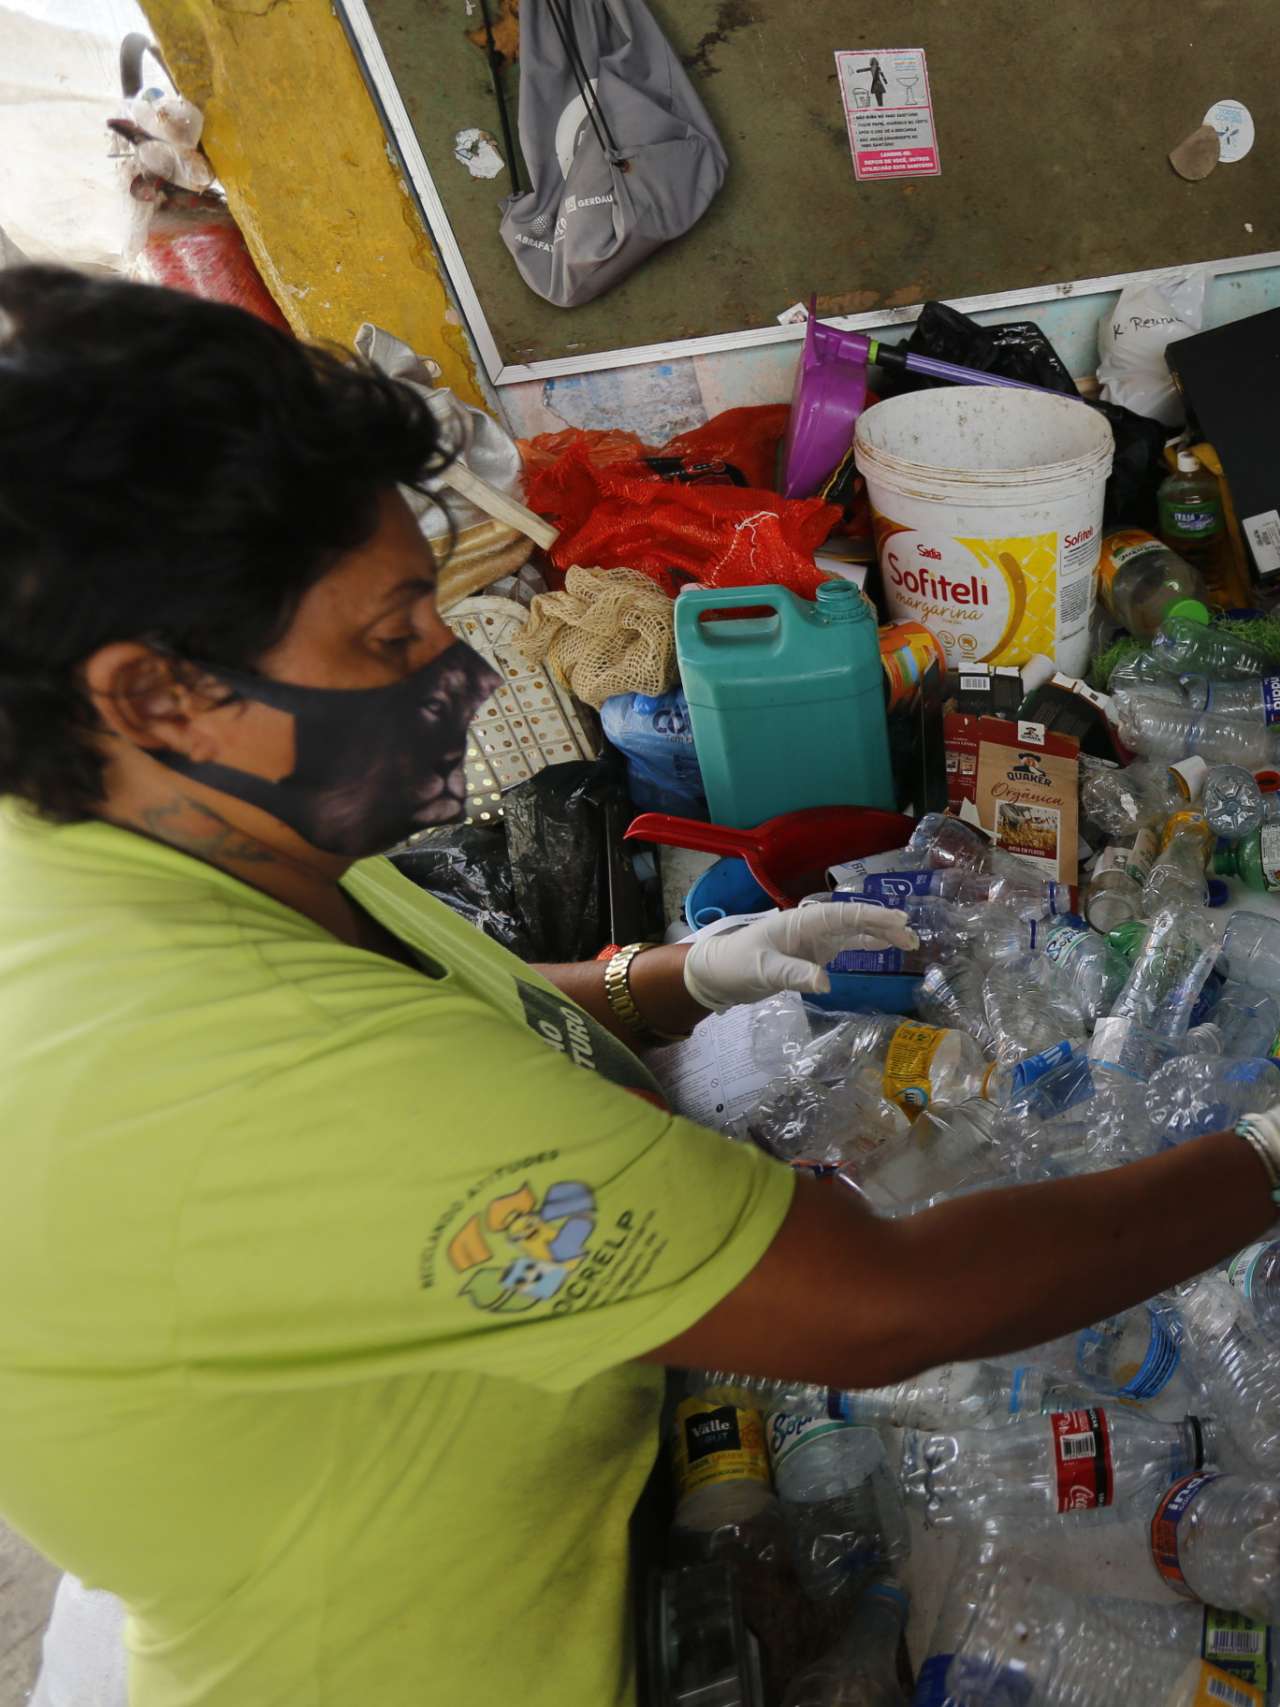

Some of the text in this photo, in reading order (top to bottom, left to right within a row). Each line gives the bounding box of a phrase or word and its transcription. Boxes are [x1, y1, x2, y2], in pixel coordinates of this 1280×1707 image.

[577, 194, 614, 209] GERDAU
[916, 543, 942, 561] Sadia
[887, 552, 989, 606] Sofiteli
[895, 591, 984, 623] margarina
[1006, 770, 1053, 787] QUAKER
[692, 1419, 731, 1437] Valle
